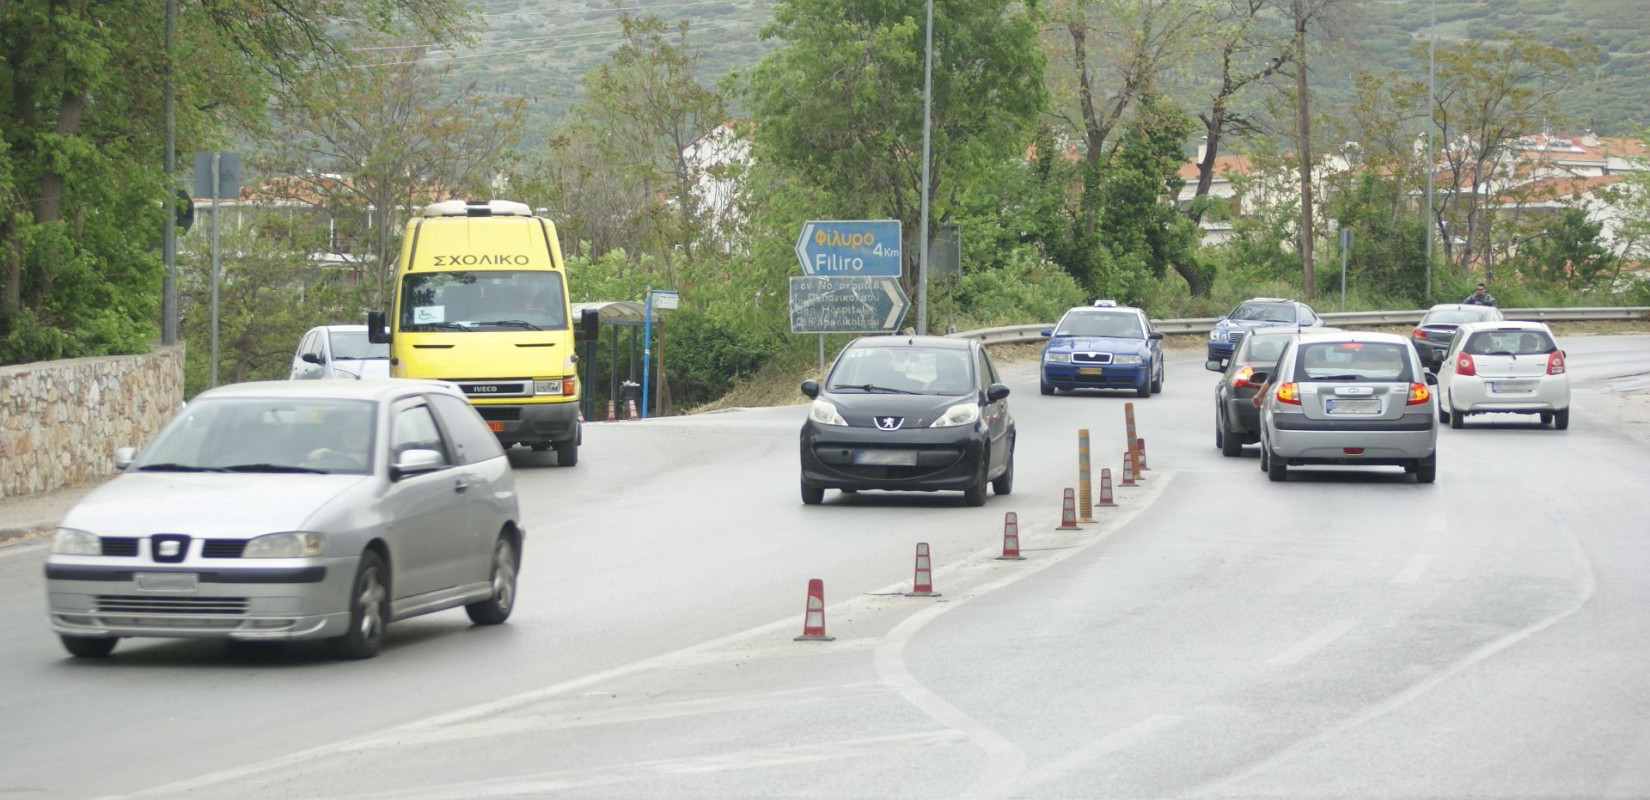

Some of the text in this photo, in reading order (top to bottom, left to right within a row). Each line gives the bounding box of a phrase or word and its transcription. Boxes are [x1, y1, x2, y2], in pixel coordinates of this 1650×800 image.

[815, 229, 875, 250] Φίλυρο
[434, 254, 530, 266] ΣΧΟΛΙΚΟ
[815, 253, 864, 271] Filiro
[473, 385, 498, 393] IVECO
